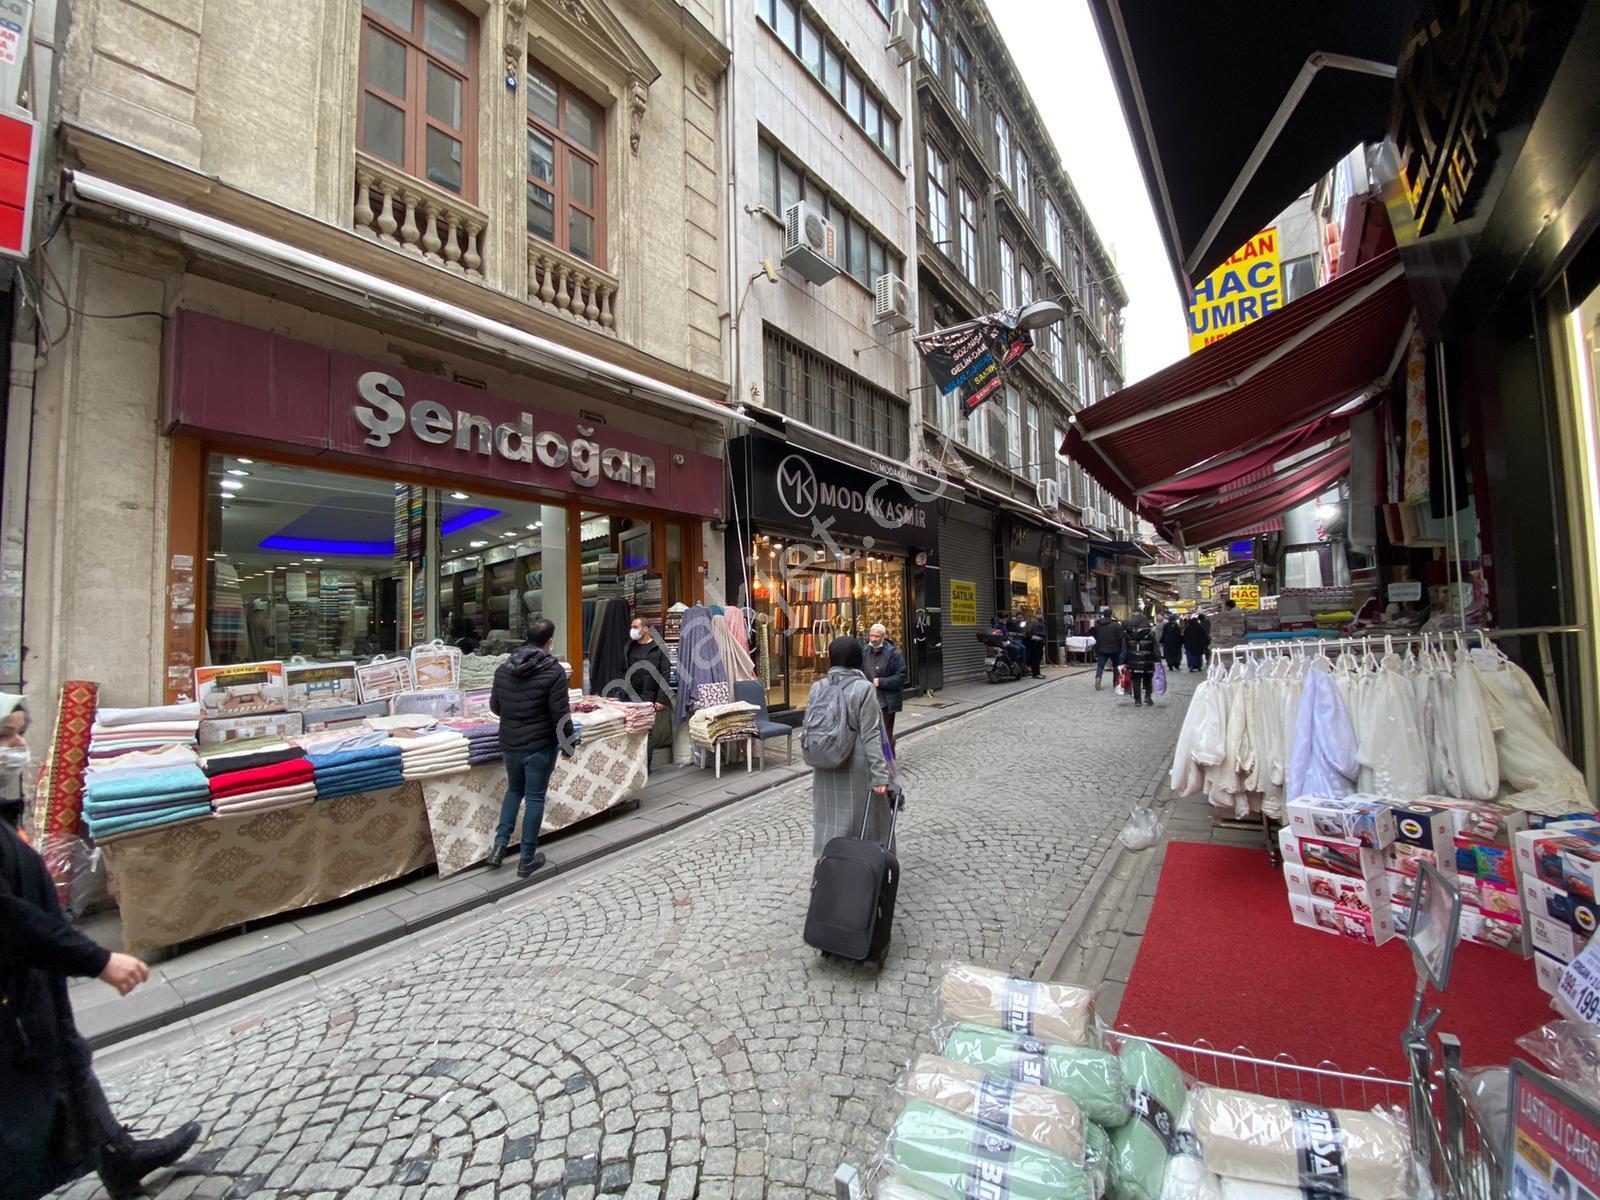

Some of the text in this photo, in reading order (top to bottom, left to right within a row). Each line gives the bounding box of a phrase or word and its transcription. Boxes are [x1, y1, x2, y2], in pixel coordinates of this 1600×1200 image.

[1190, 289, 1278, 334] UMRE
[354, 371, 656, 489] Şendoğan
[1231, 590, 1258, 599] HAC
